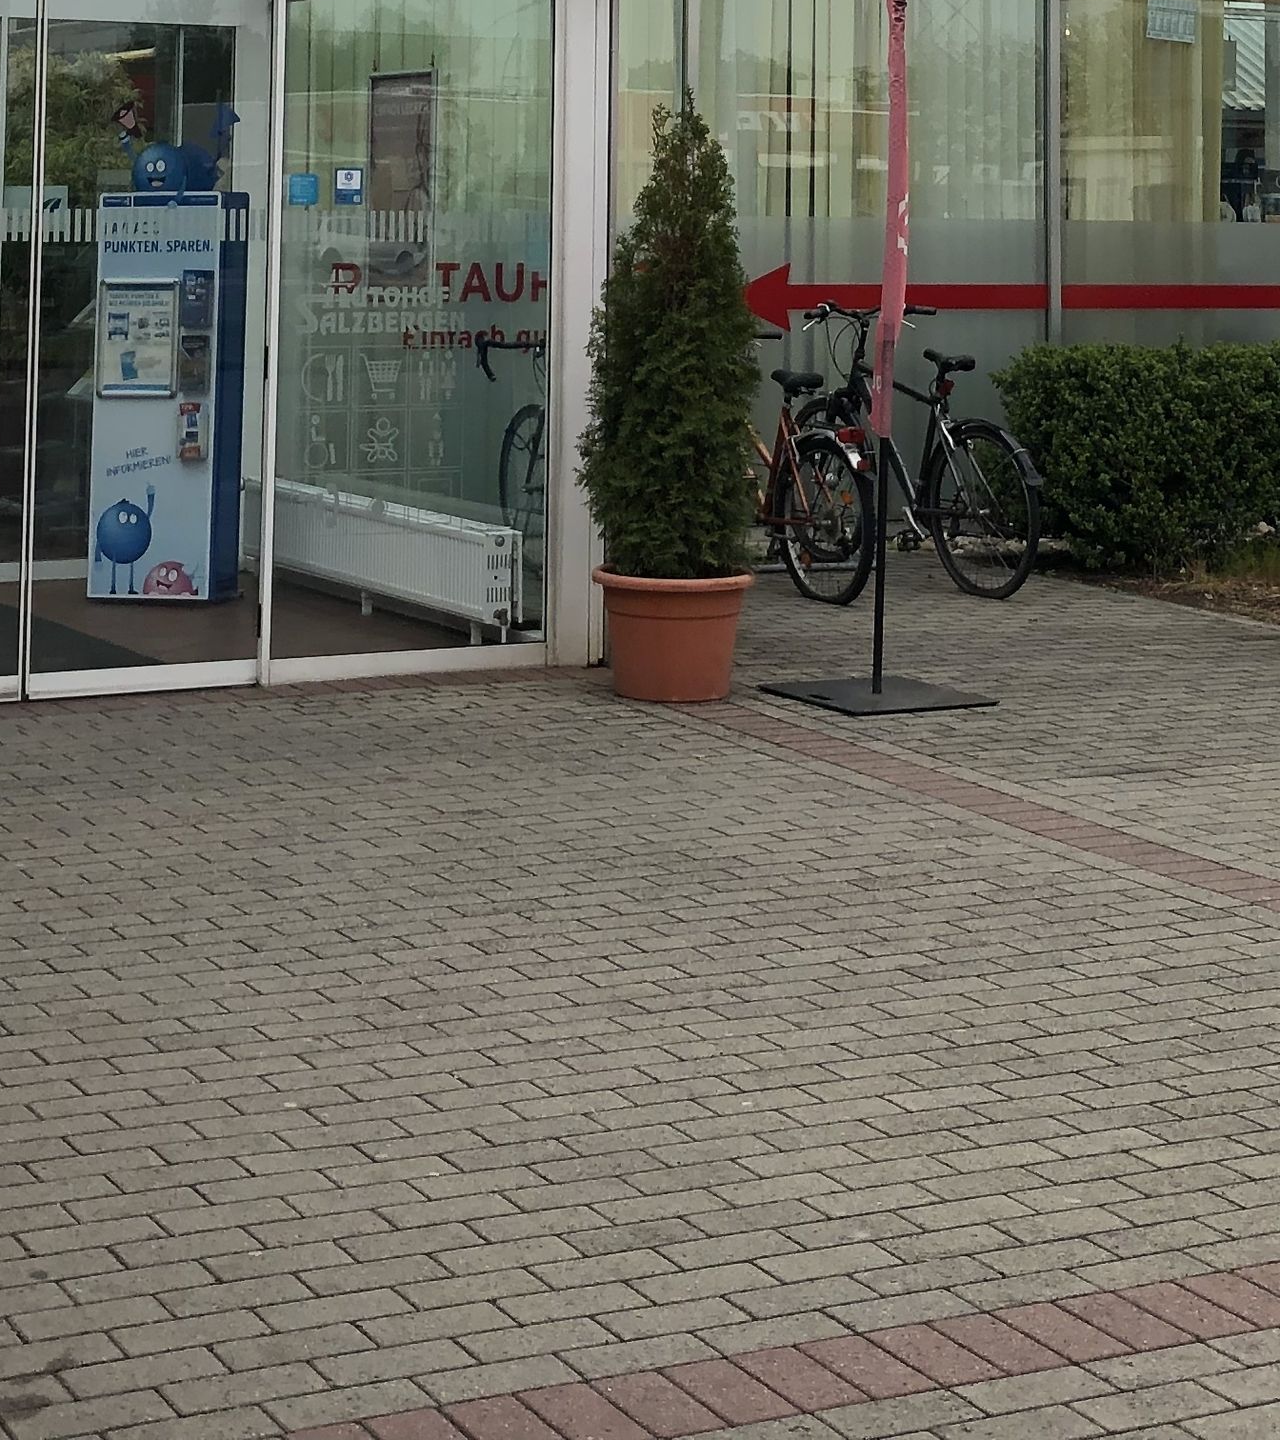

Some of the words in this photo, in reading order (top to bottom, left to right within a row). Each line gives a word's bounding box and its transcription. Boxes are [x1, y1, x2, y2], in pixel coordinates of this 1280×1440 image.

[104, 240, 163, 254] PUNKTEN.
[166, 239, 214, 253] SPAREN.
[295, 294, 466, 336] SALZBERGEN
[125, 446, 149, 459] HIER
